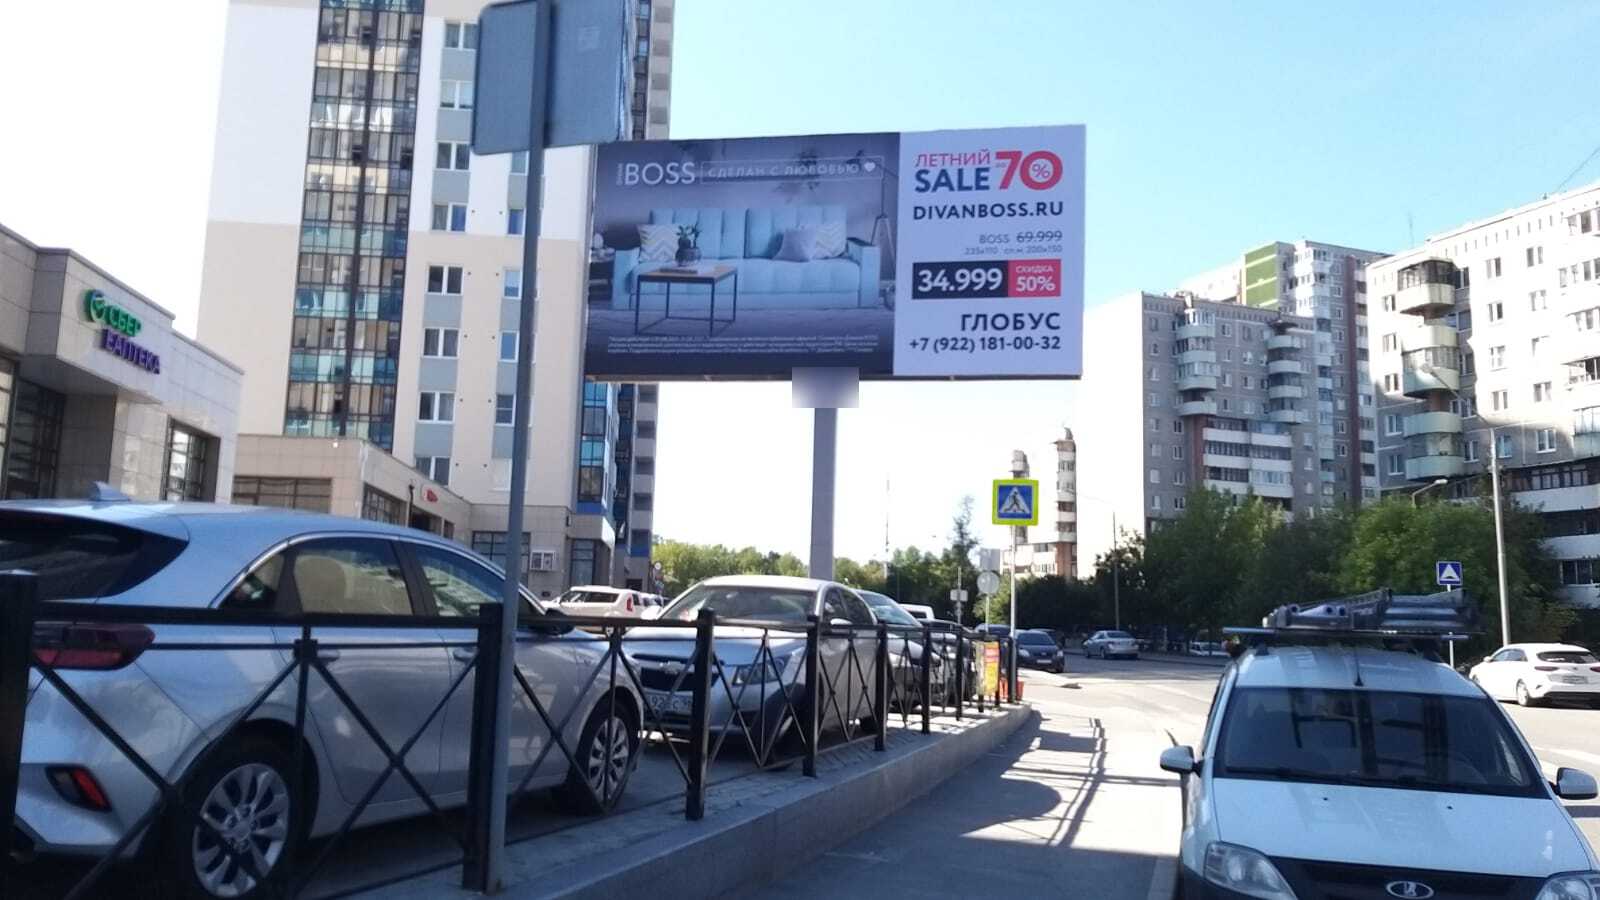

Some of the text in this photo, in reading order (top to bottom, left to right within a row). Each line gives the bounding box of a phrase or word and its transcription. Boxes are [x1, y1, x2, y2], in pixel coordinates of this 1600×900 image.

[915, 148, 990, 168] ЛЕТНИЙ
[624, 162, 696, 185] BOSS
[707, 167, 766, 178] СДЕЛАН
[784, 163, 860, 175] ЛЮБОВЬЮ
[914, 167, 991, 193] SALE
[912, 201, 1064, 221] DIVANBOSS.RU
[979, 231, 1063, 244] BOSS 69.999
[1015, 264, 1054, 273] СКИДКА
[917, 268, 1003, 293] 34.999
[1015, 275, 1056, 292] 50%
[961, 312, 1061, 332] ГЛОБУС
[909, 336, 1061, 354] +7 (922) 181-00-32
